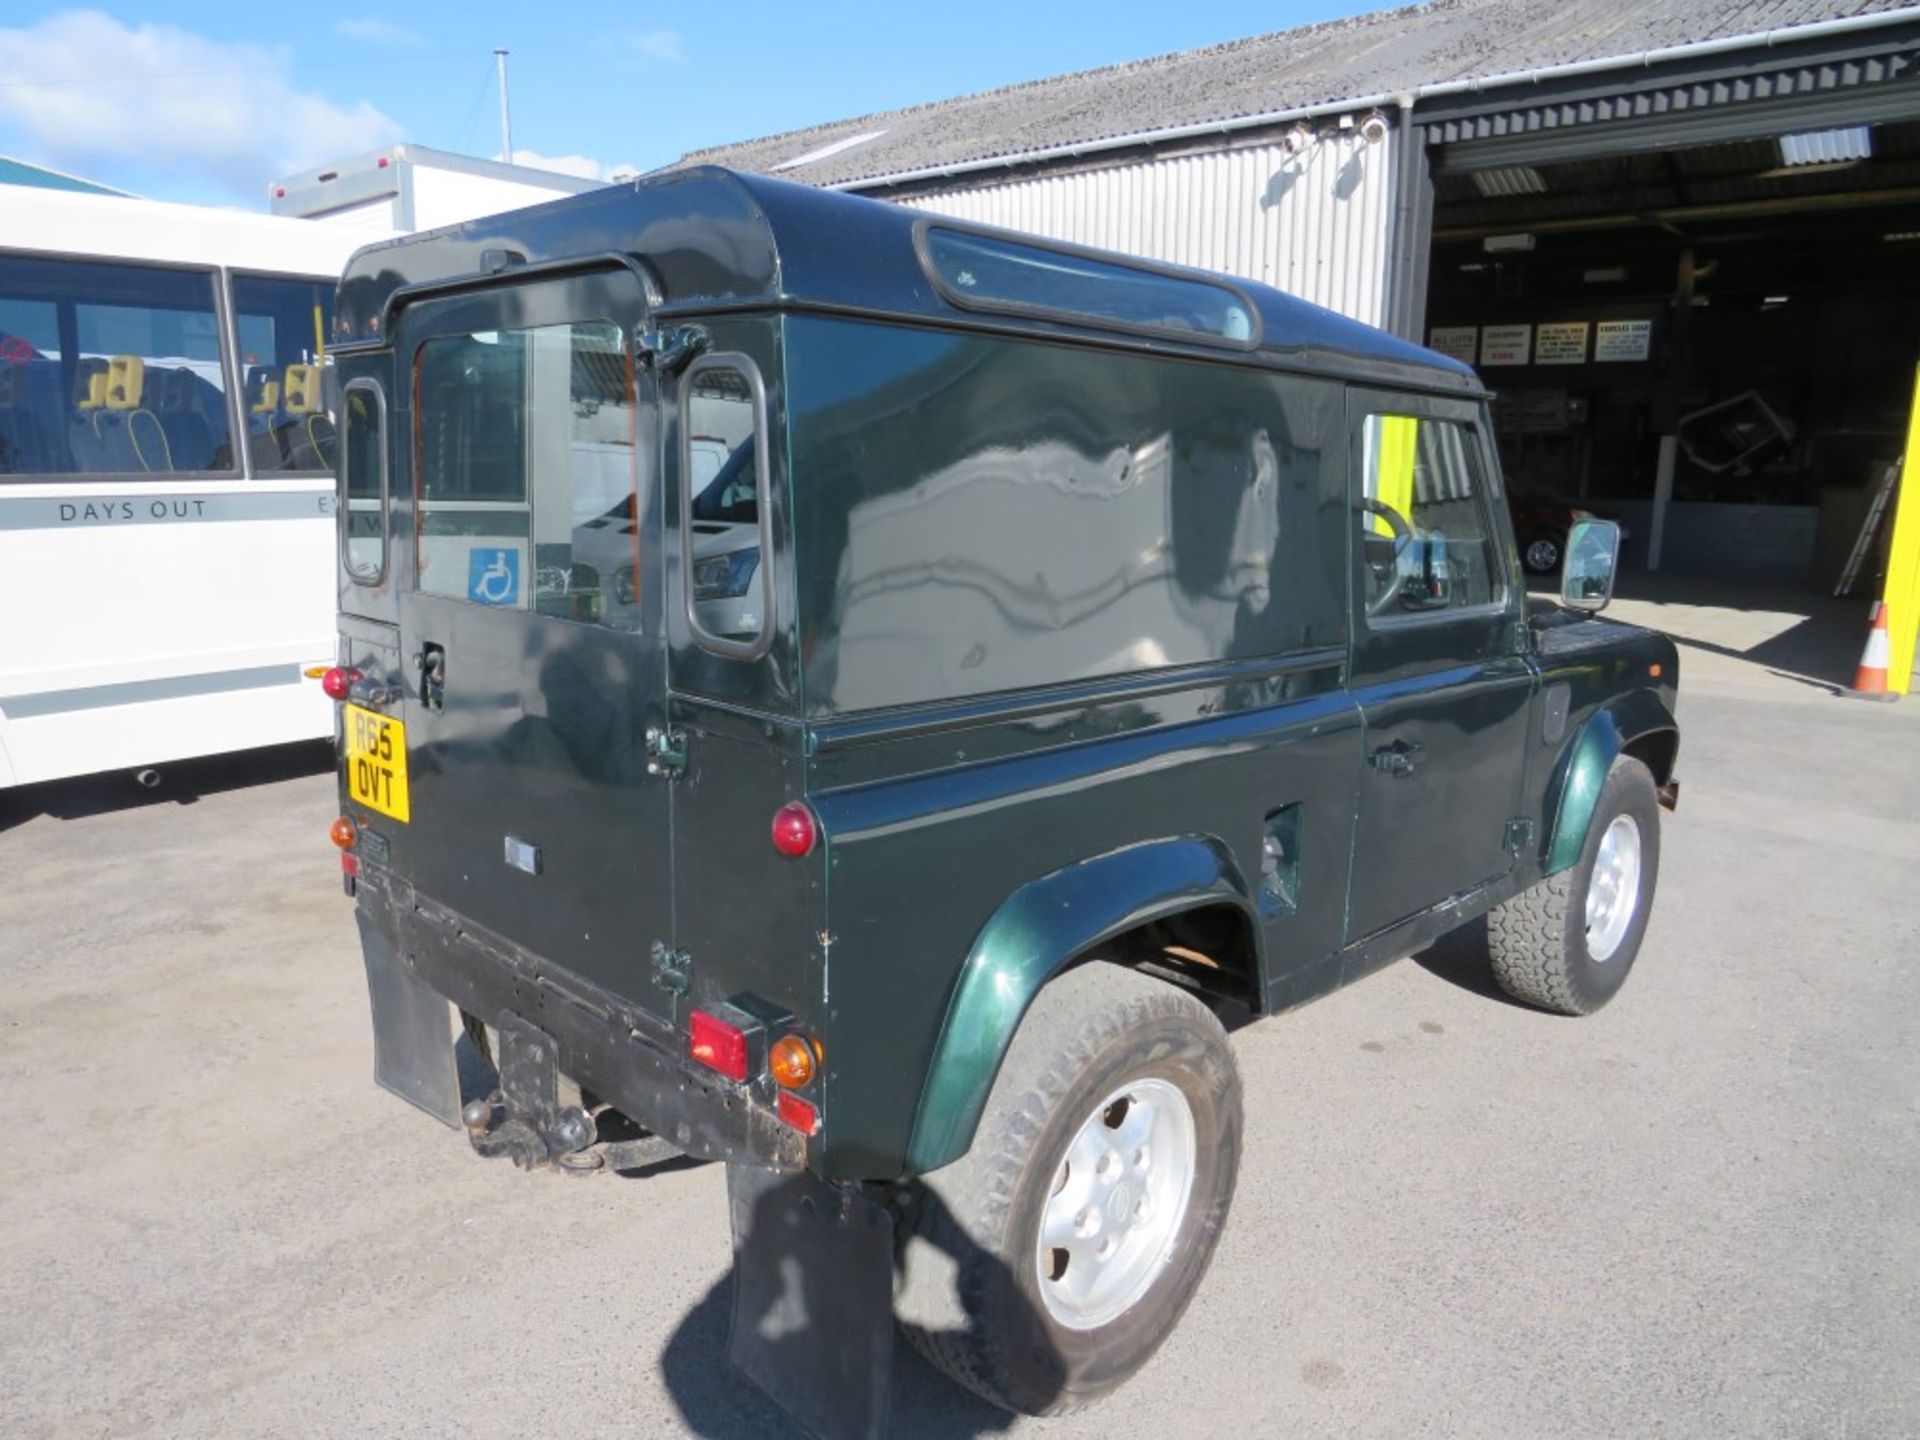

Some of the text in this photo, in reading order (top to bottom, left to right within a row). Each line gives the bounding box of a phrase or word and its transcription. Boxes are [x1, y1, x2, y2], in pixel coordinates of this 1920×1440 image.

[59, 501, 134, 522] DAYS
[150, 500, 206, 518] OUT
[356, 711, 392, 762] R65
[358, 757, 394, 808] OVT
